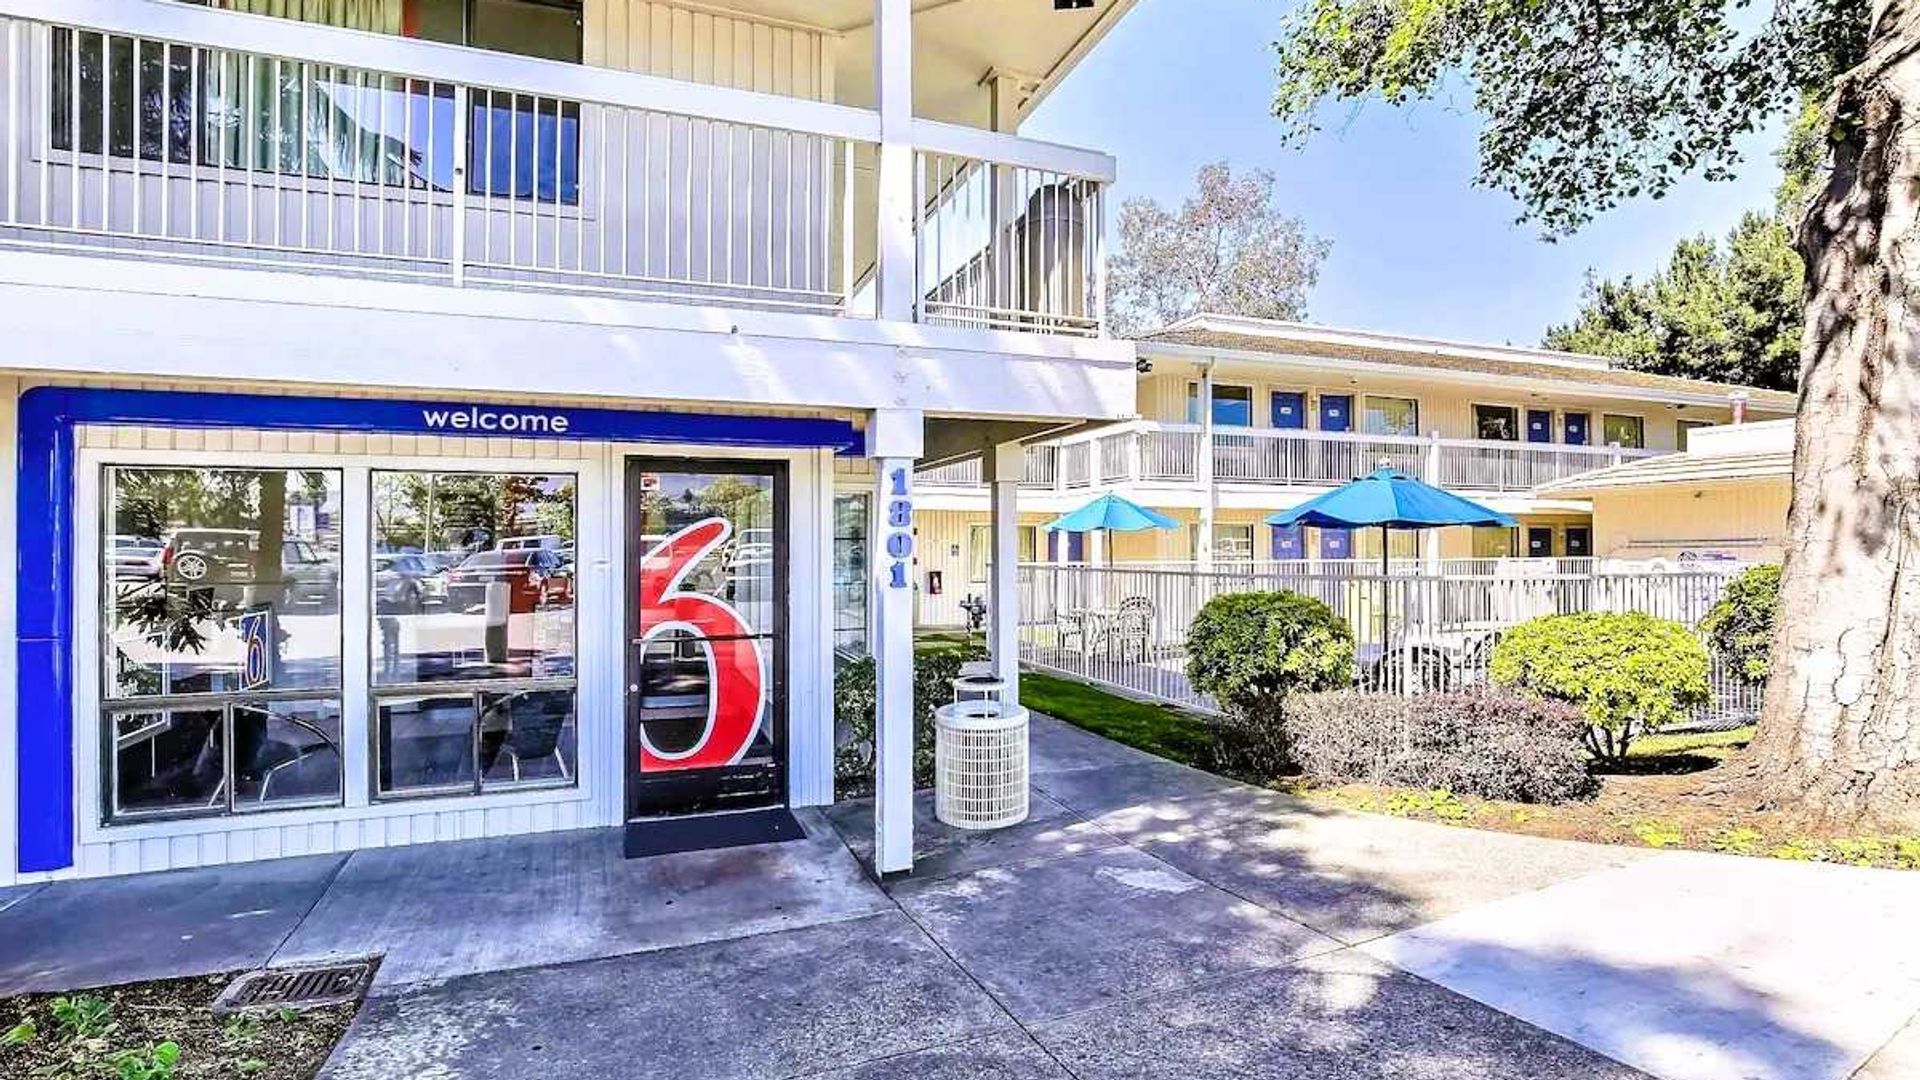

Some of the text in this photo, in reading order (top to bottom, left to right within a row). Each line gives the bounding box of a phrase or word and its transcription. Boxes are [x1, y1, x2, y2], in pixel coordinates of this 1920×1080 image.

[423, 406, 569, 432] welcome
[886, 467, 912, 588] 1801
[640, 516, 765, 773] 6
